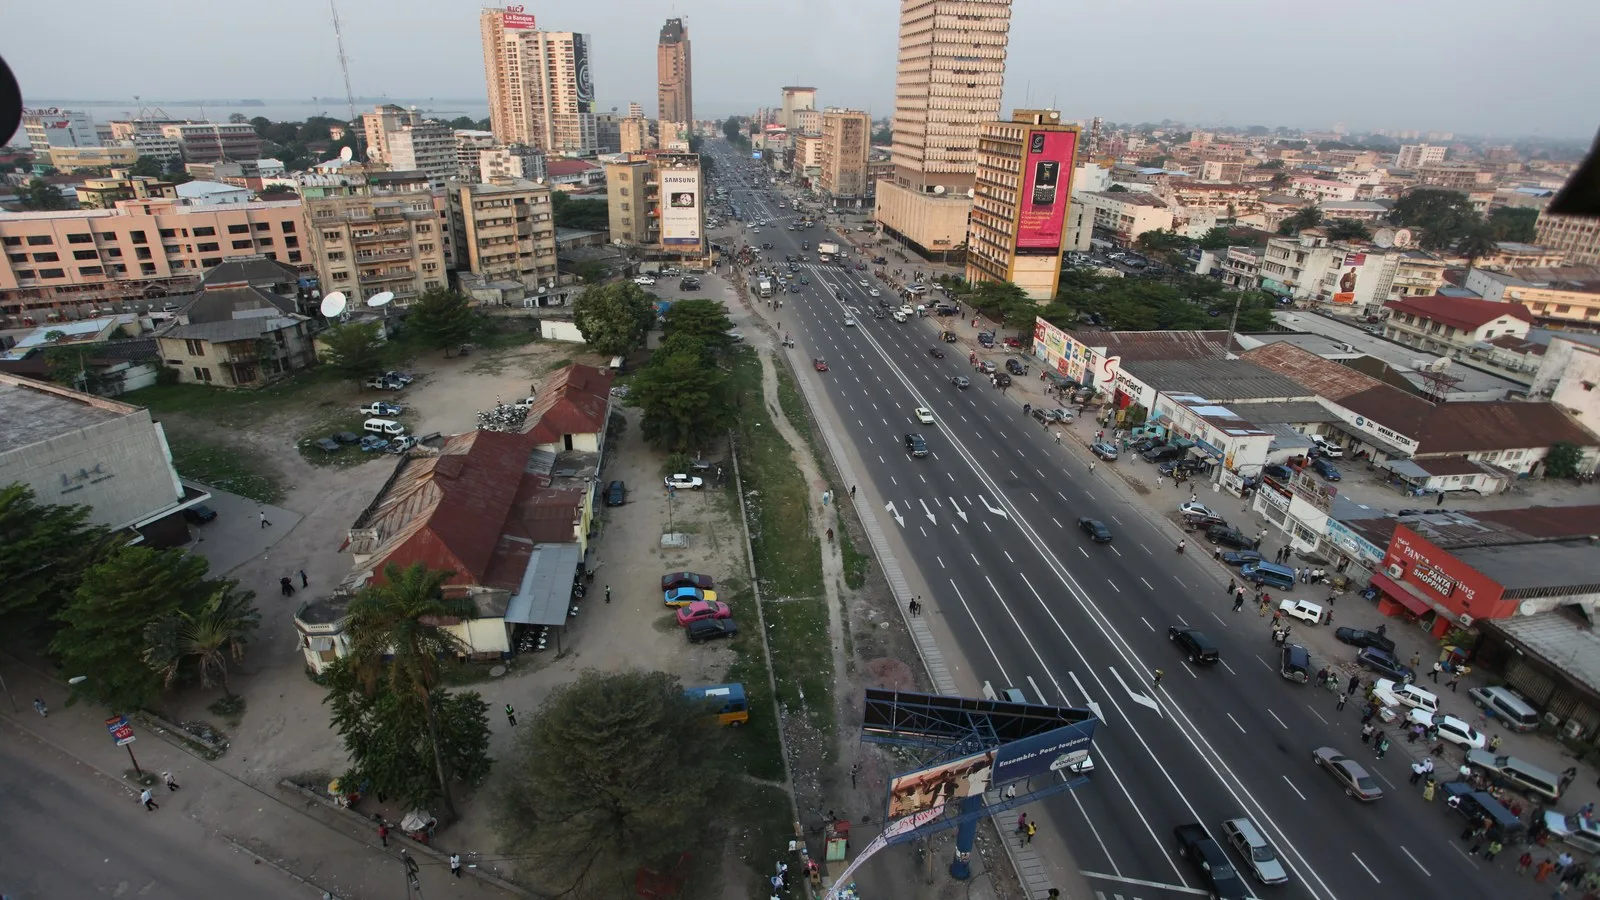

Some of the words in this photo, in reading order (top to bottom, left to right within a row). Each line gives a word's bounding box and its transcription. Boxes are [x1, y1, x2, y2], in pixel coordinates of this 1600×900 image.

[1102, 359, 1142, 395] Standard
[1326, 517, 1348, 533] BABY
[1355, 536, 1384, 560] CENTER
[1413, 568, 1449, 596] SHOPPING
[1428, 569, 1451, 589] PANTA
[999, 752, 1037, 767] Ensemble.
[1039, 746, 1057, 755] Pour
[1058, 736, 1090, 749] toujours.
